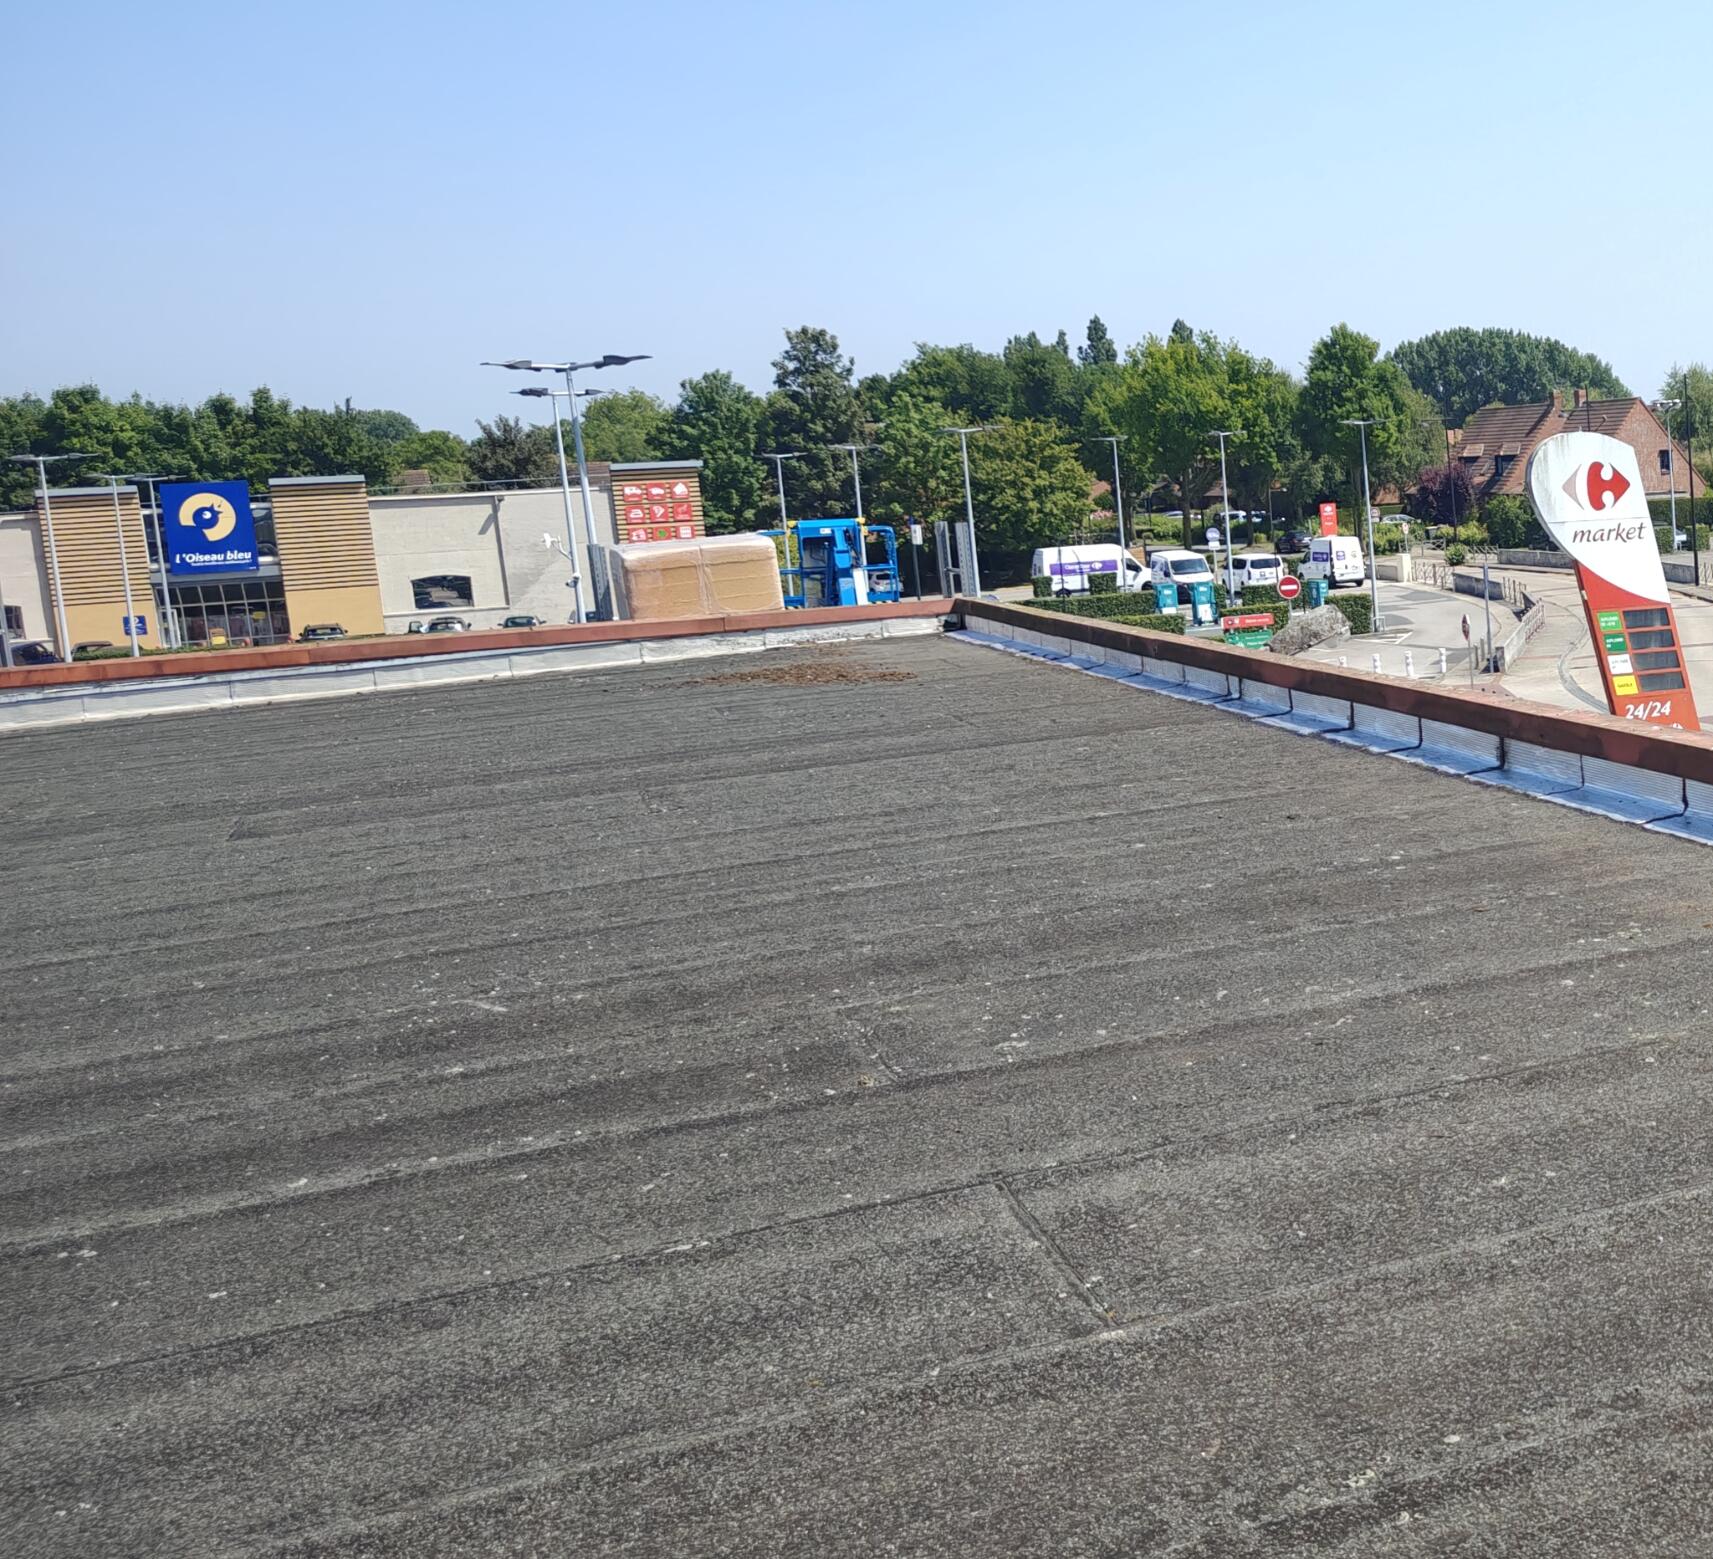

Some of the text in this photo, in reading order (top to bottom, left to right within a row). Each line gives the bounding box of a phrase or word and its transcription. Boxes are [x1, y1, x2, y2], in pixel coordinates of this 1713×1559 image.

[1572, 522, 1647, 543] market
[226, 549, 252, 560] bleu
[1625, 701, 1671, 720] 24/24
